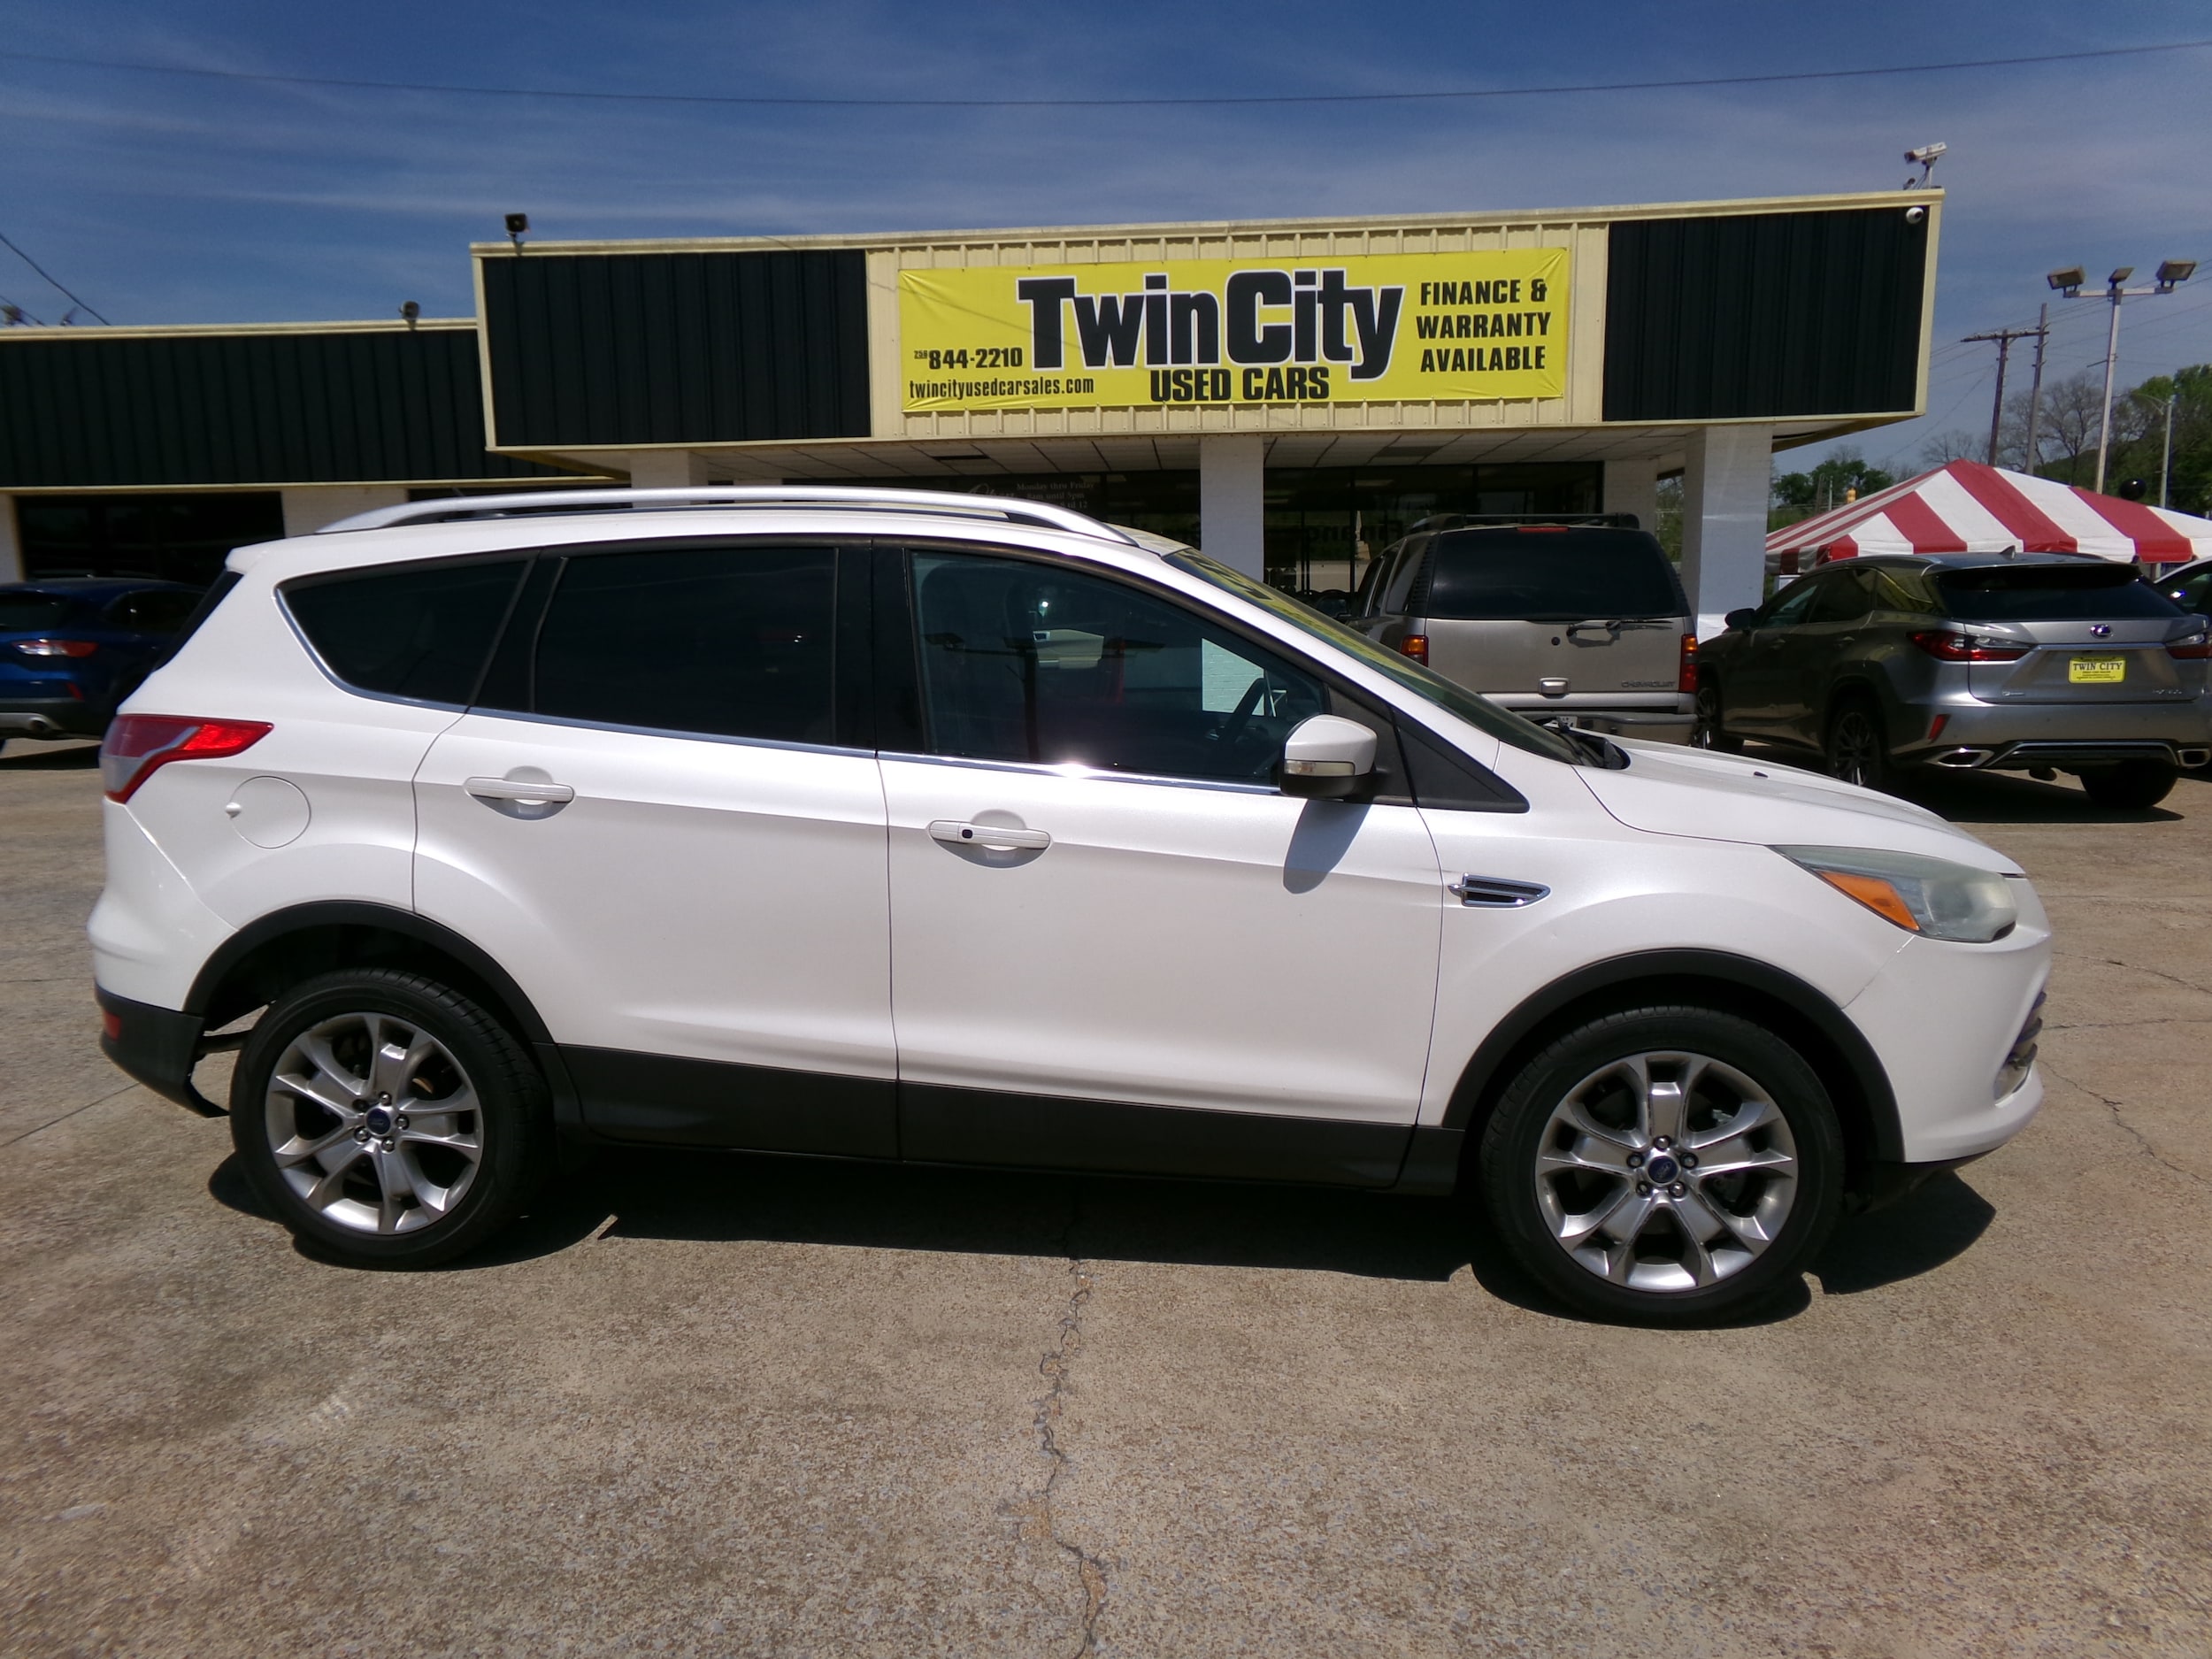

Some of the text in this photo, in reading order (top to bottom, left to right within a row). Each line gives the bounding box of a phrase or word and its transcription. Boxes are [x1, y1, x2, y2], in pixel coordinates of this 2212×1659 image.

[1420, 278, 1548, 306] FINANCE &
[1417, 311, 1551, 340] WARRANTY
[929, 347, 1023, 370] 844-2210
[1420, 345, 1546, 373] AVAILABLE
[910, 377, 1094, 400] twincityusedcarsales.com
[1150, 366, 1330, 403] USED CARS
[2100, 662, 2123, 671] CITY
